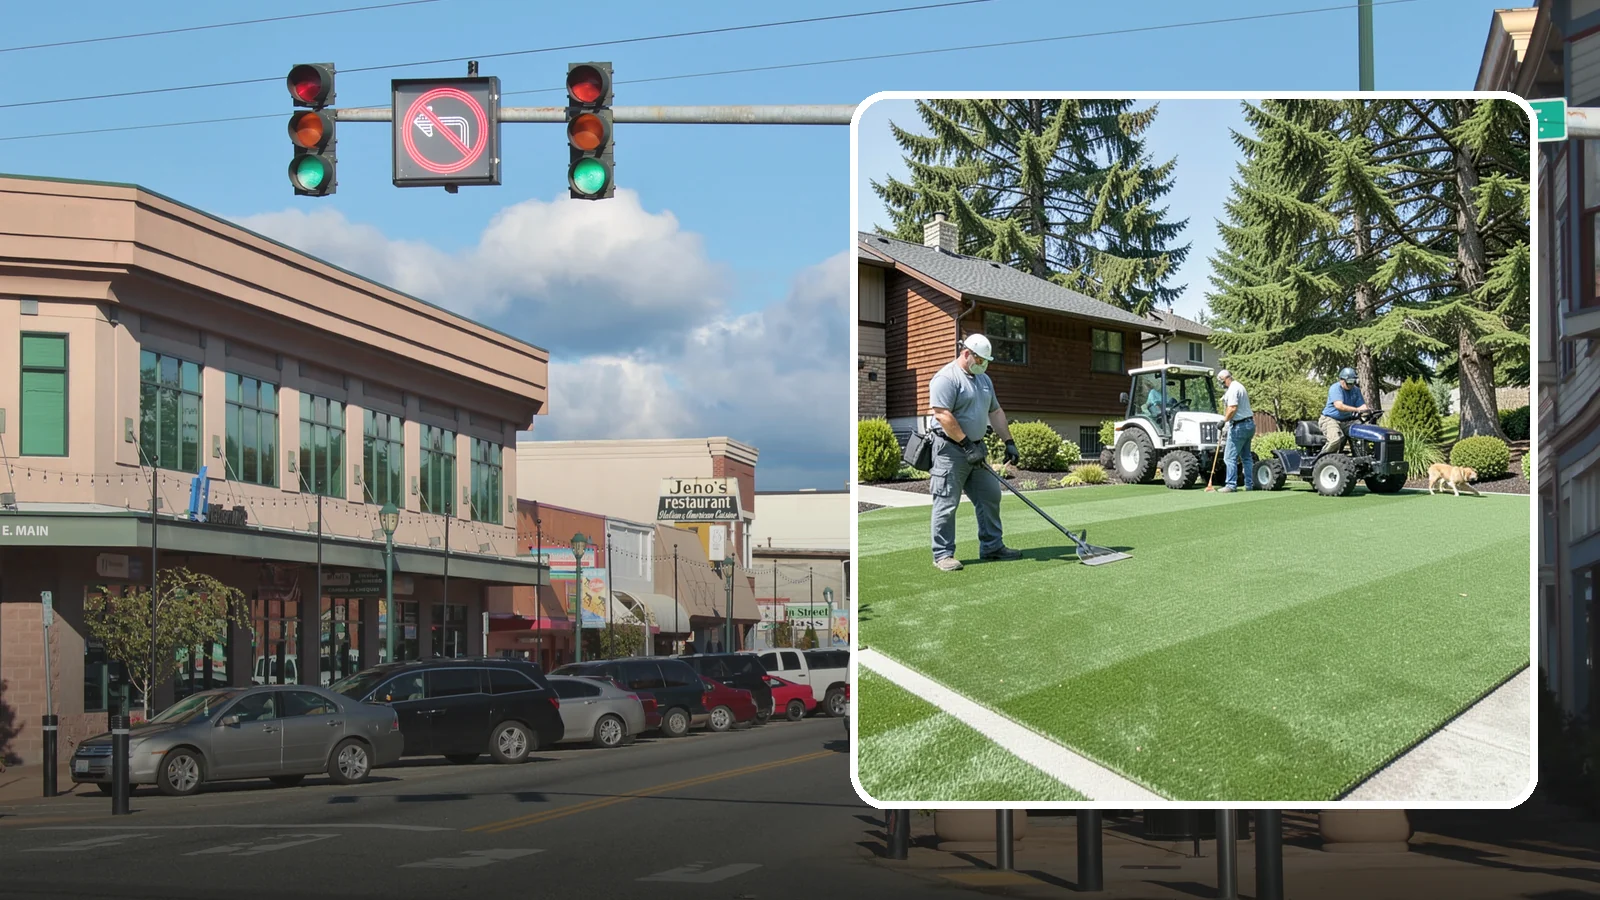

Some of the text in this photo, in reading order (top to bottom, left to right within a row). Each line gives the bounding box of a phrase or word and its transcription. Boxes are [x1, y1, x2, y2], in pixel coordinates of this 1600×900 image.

[670, 480, 727, 494] Jeno's
[665, 496, 731, 509] restaurant
[659, 510, 681, 519] Italian
[686, 510, 714, 519] American
[715, 510, 737, 519] Cuisine
[2, 525, 49, 536] E. MAIN
[798, 608, 828, 616] Street
[791, 619, 823, 627] lass
